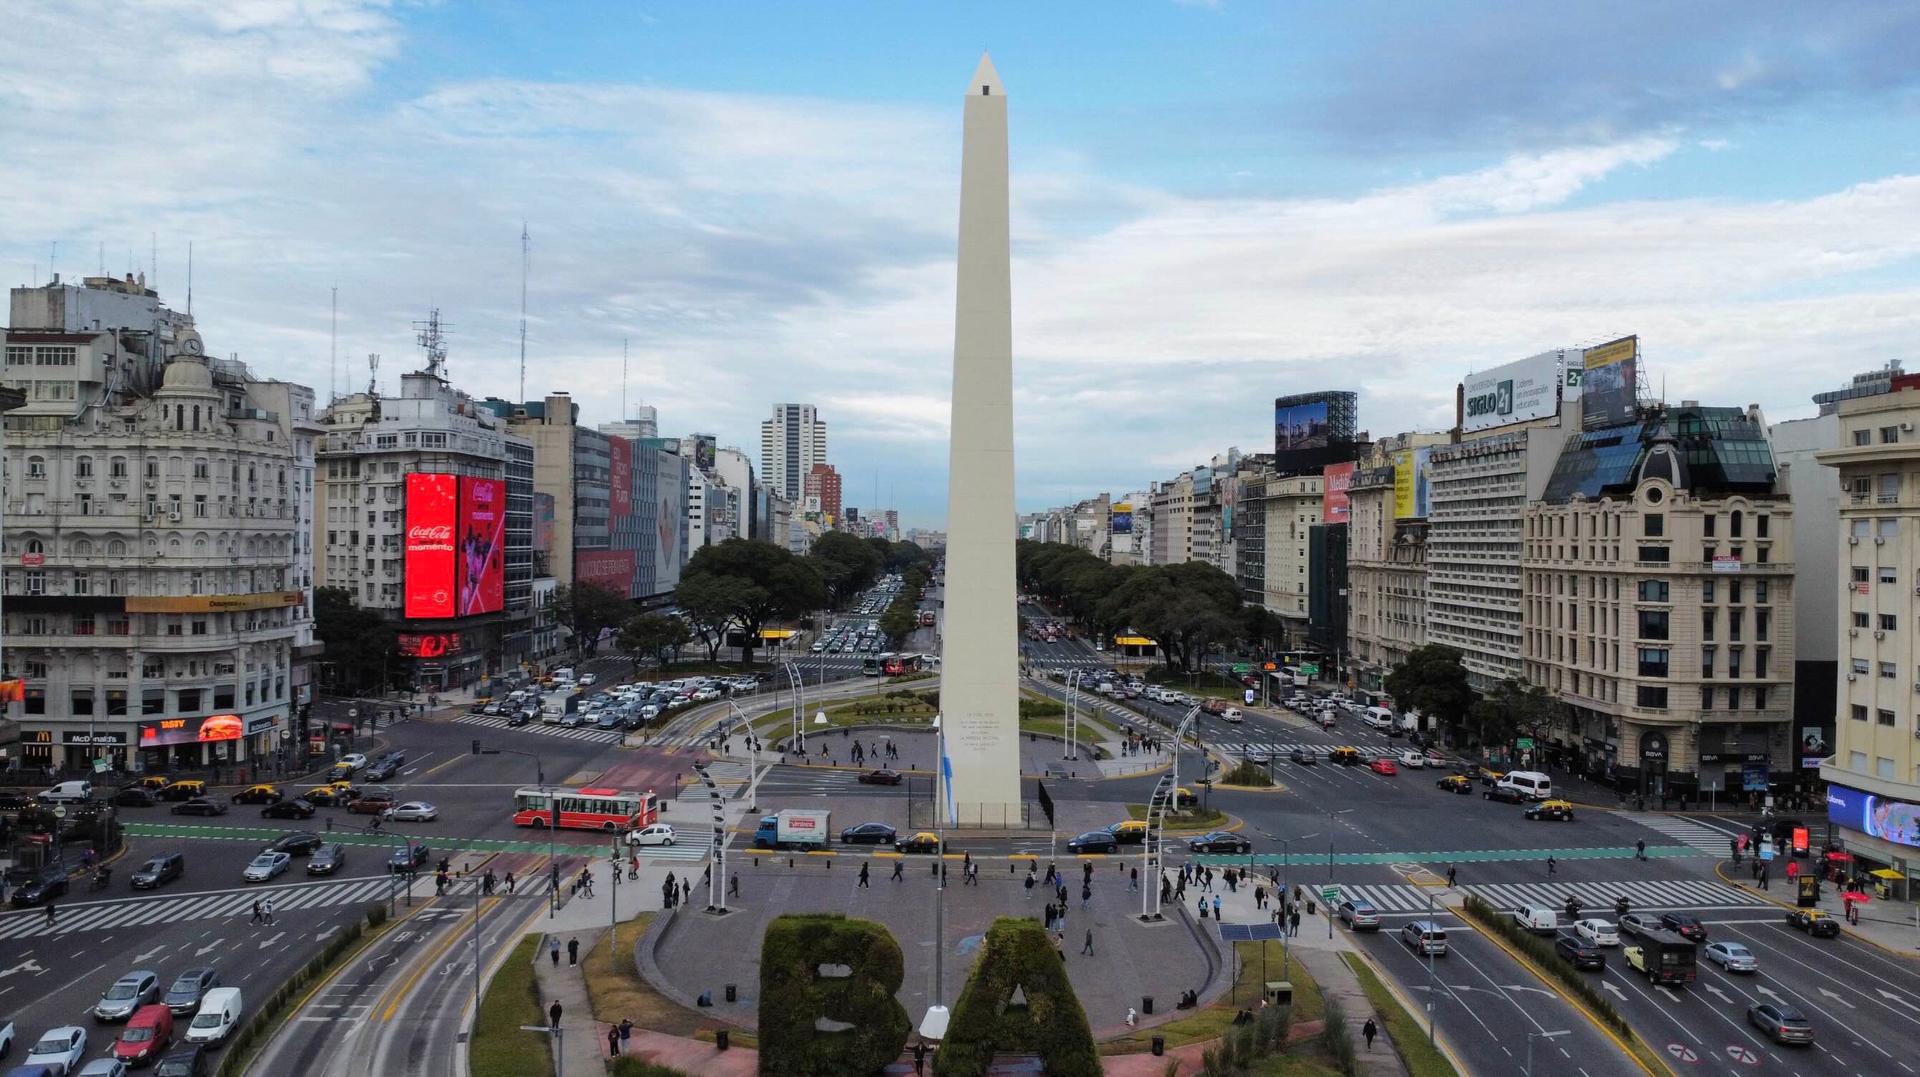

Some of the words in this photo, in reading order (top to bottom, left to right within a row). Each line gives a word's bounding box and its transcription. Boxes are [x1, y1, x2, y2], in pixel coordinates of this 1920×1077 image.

[1568, 372, 1582, 388] 21
[1467, 392, 1497, 417] SIGLO
[1498, 386, 1511, 414] 21
[160, 720, 185, 729] TASTY
